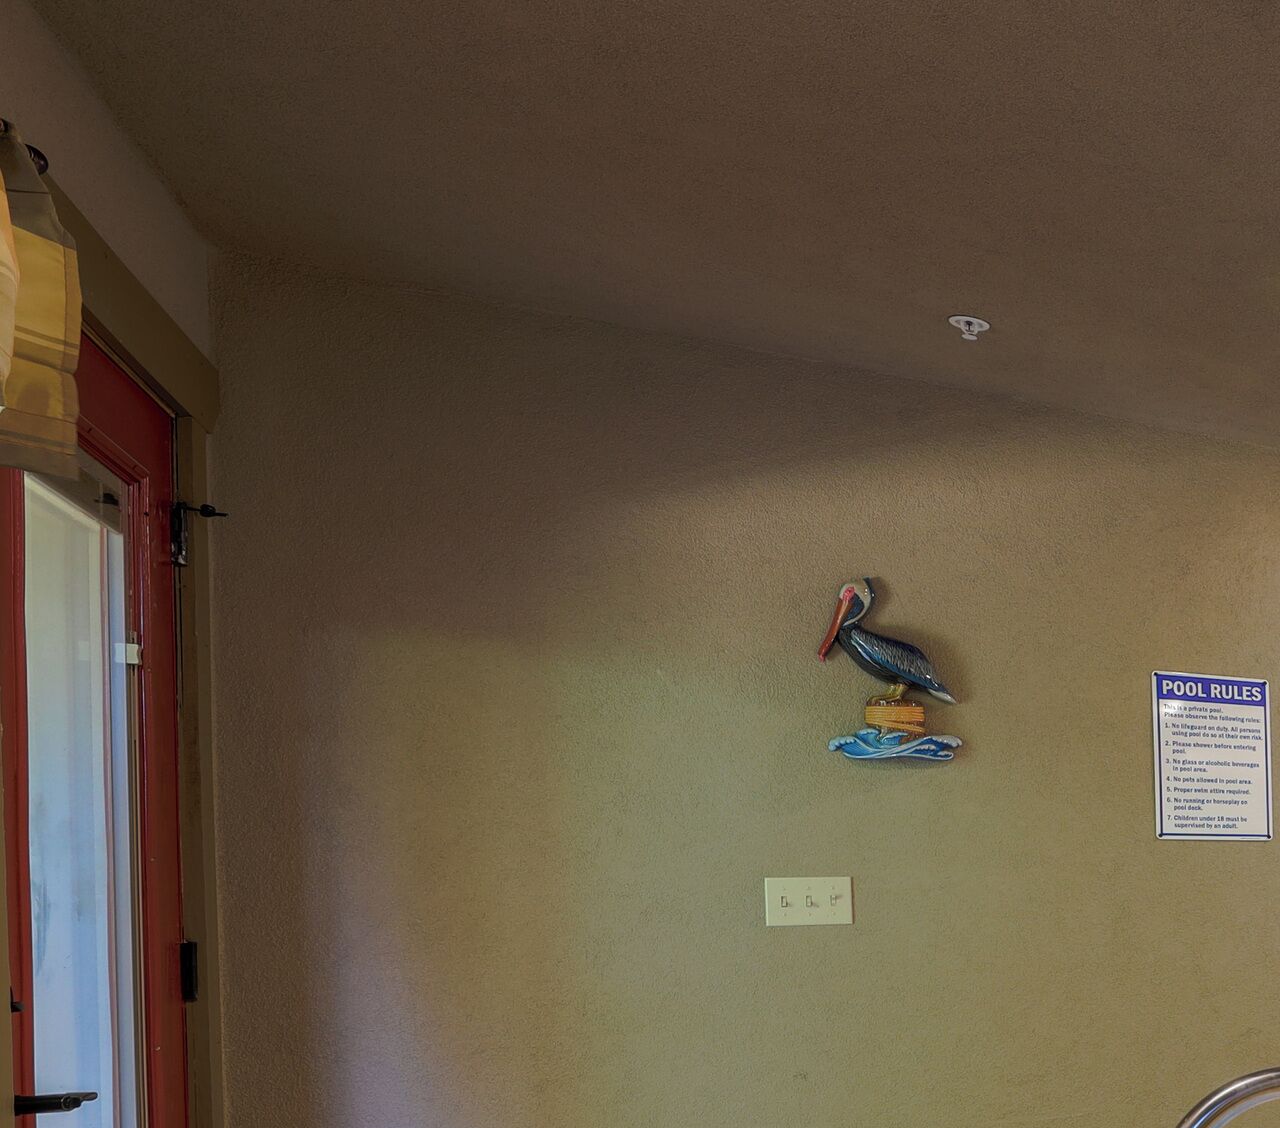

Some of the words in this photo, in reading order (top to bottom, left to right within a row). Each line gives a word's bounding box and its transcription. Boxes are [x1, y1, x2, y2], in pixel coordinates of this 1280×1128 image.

[1162, 680, 1206, 697] POOL
[1210, 684, 1262, 701] RULES
[1181, 723, 1207, 731] lifeguard
